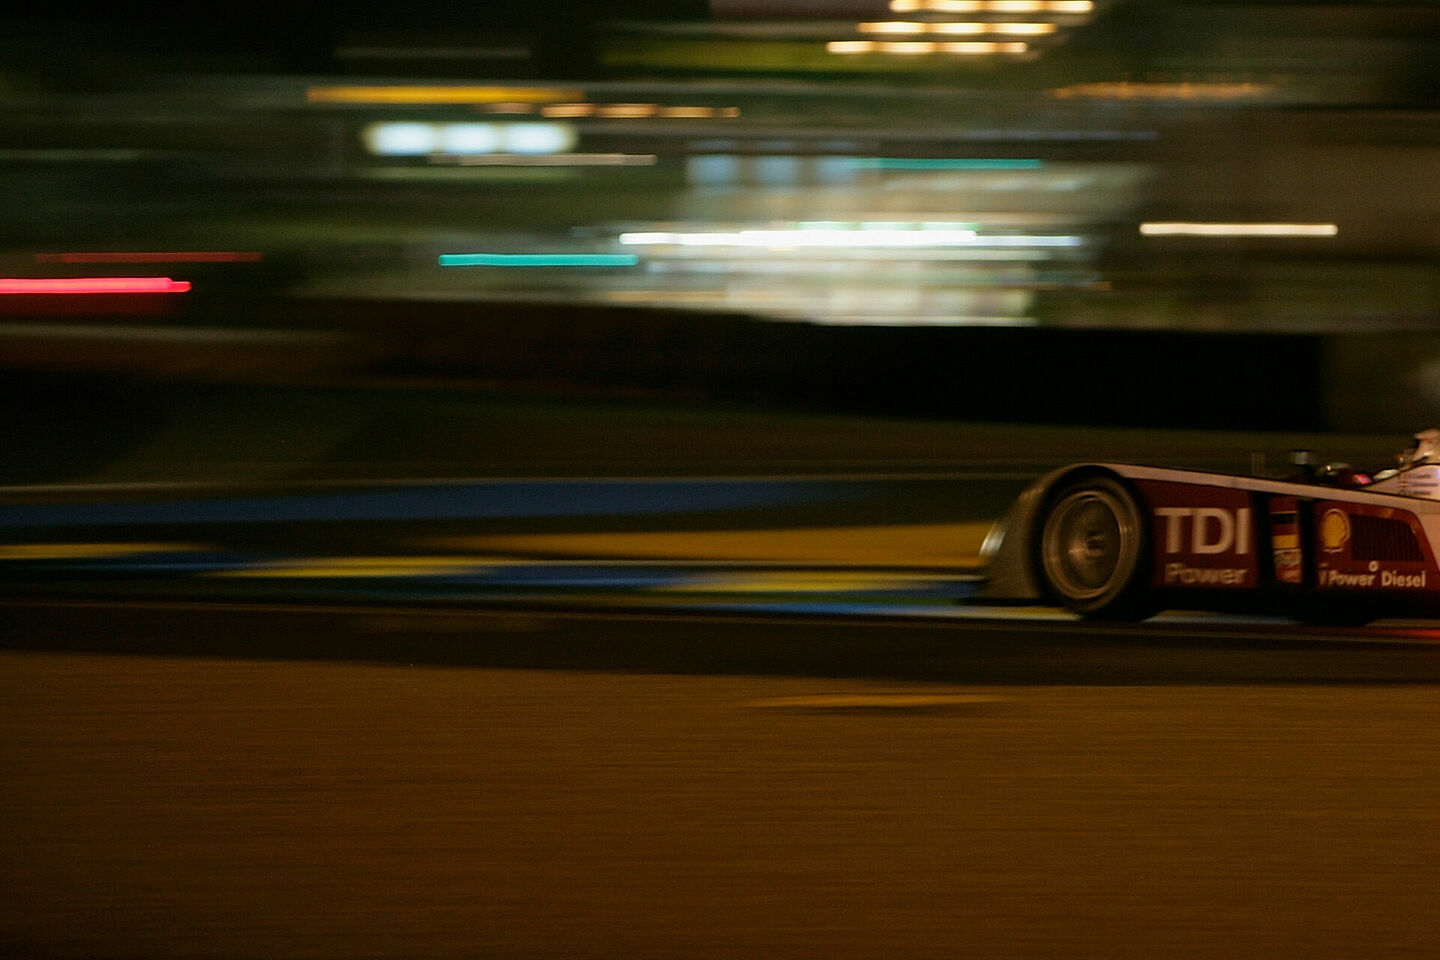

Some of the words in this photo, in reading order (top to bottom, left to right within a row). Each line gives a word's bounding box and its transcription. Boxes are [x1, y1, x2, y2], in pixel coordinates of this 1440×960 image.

[1153, 507, 1251, 555] TDI
[1164, 562, 1248, 585] Power
[1328, 570, 1376, 586] Power
[1381, 570, 1427, 587] Diesel
